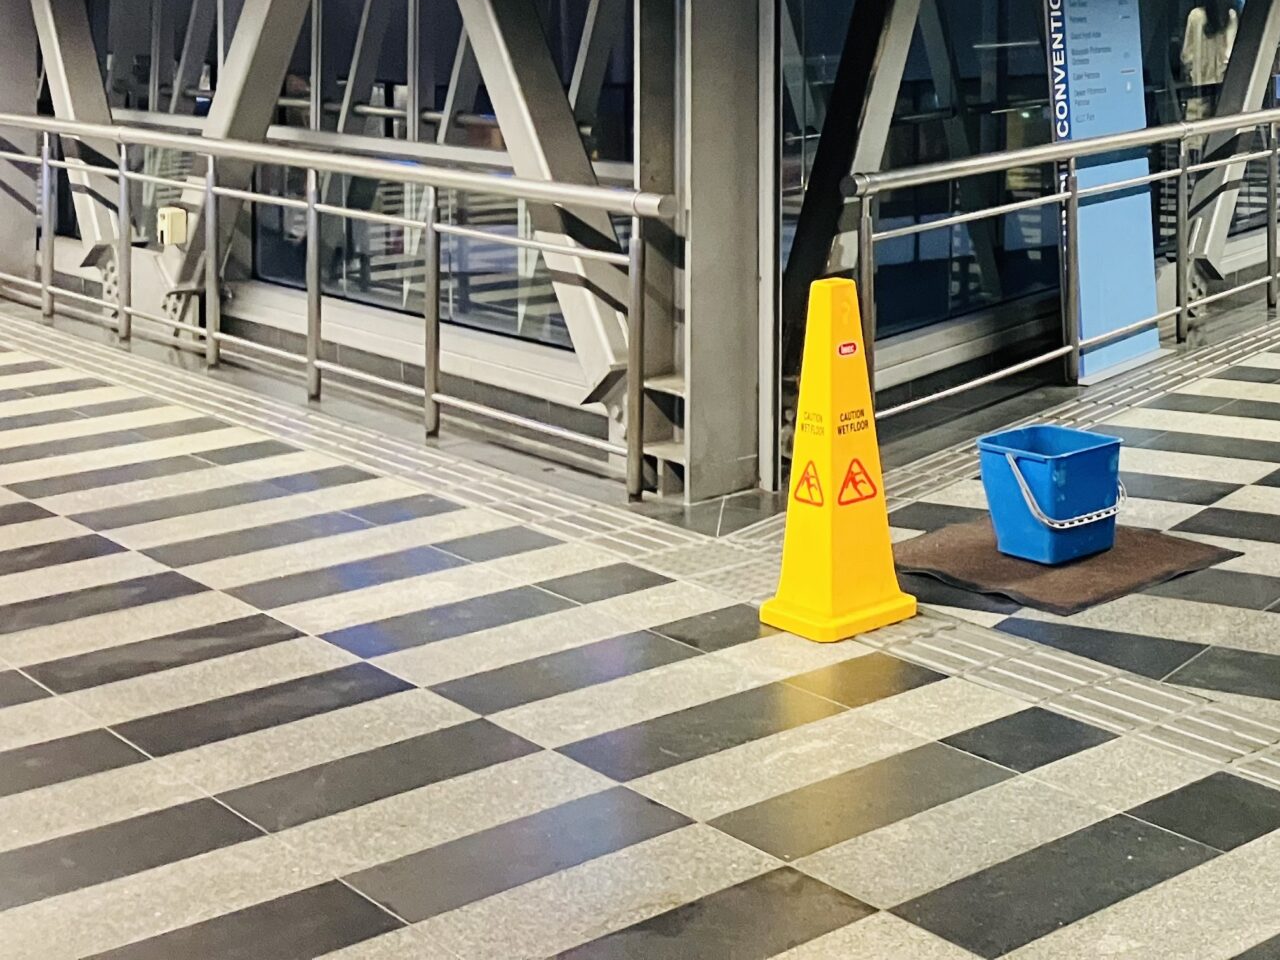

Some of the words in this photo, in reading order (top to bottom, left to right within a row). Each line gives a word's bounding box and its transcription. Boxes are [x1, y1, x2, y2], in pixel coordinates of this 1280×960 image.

[840, 409, 864, 422] CAUTION
[838, 424, 850, 435] WET
[850, 420, 868, 432] FLOOR
